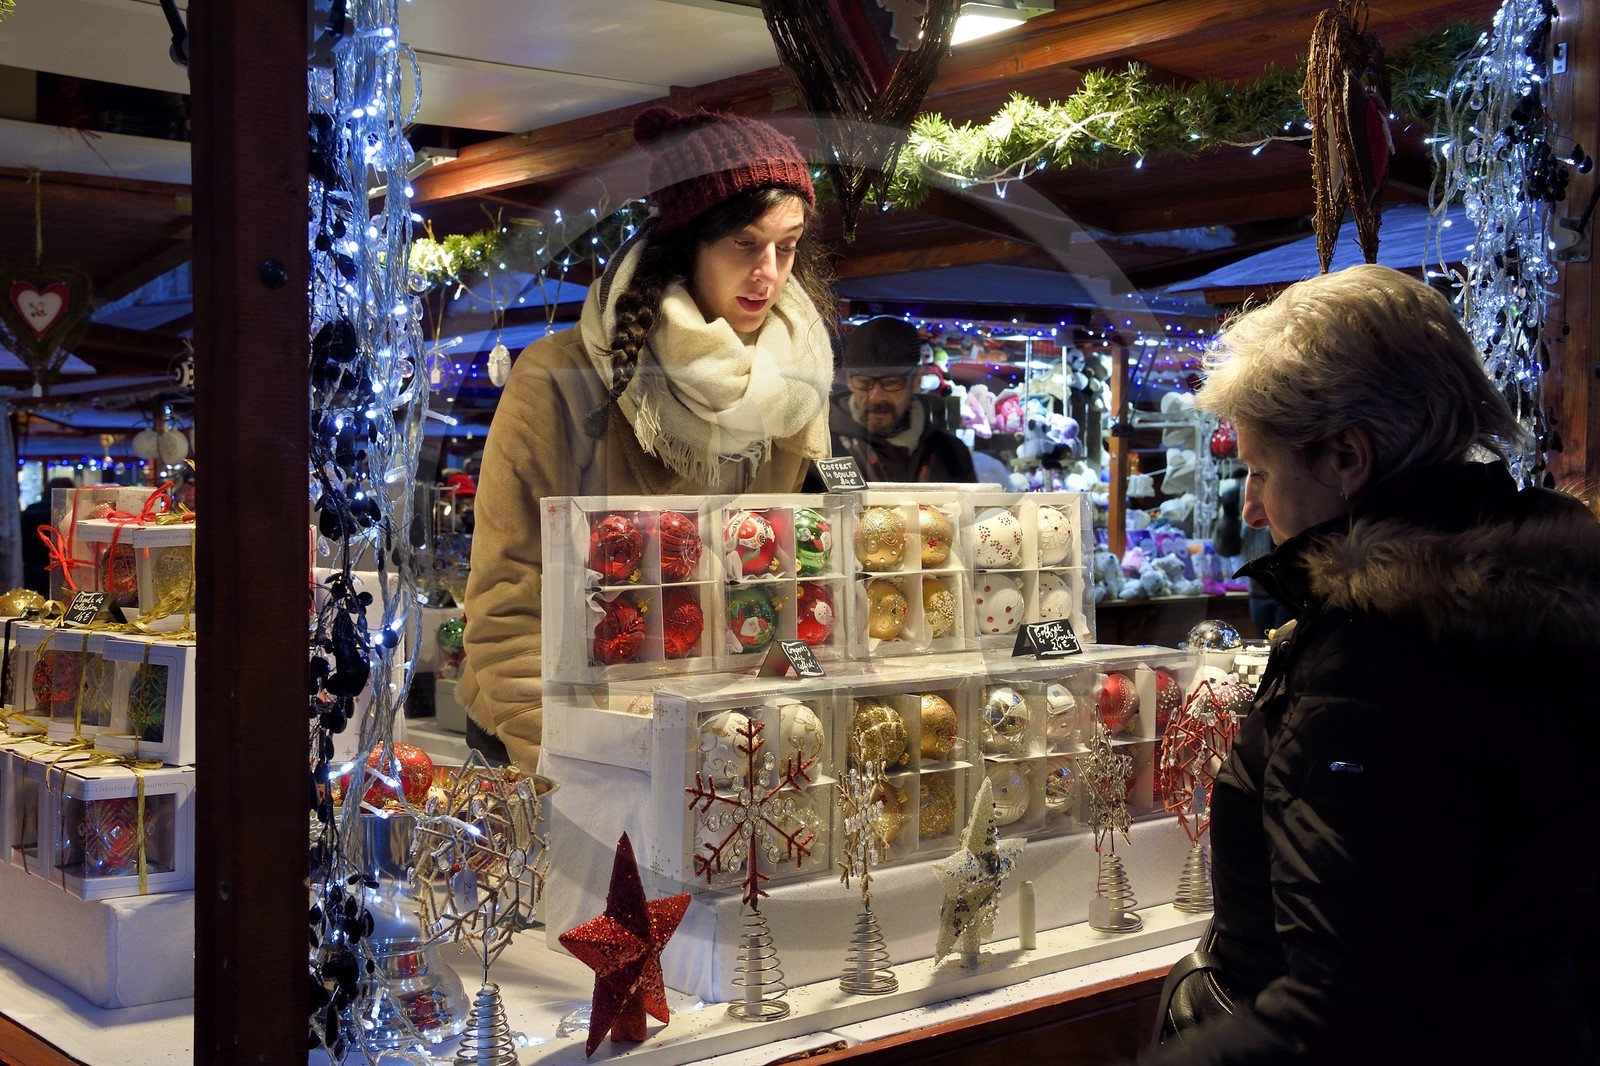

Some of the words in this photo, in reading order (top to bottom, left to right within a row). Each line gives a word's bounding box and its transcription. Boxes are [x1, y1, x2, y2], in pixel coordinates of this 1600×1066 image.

[821, 462, 852, 471] COFFRET
[825, 471, 833, 479] 4
[95, 785, 130, 793] CHRISTMAS
